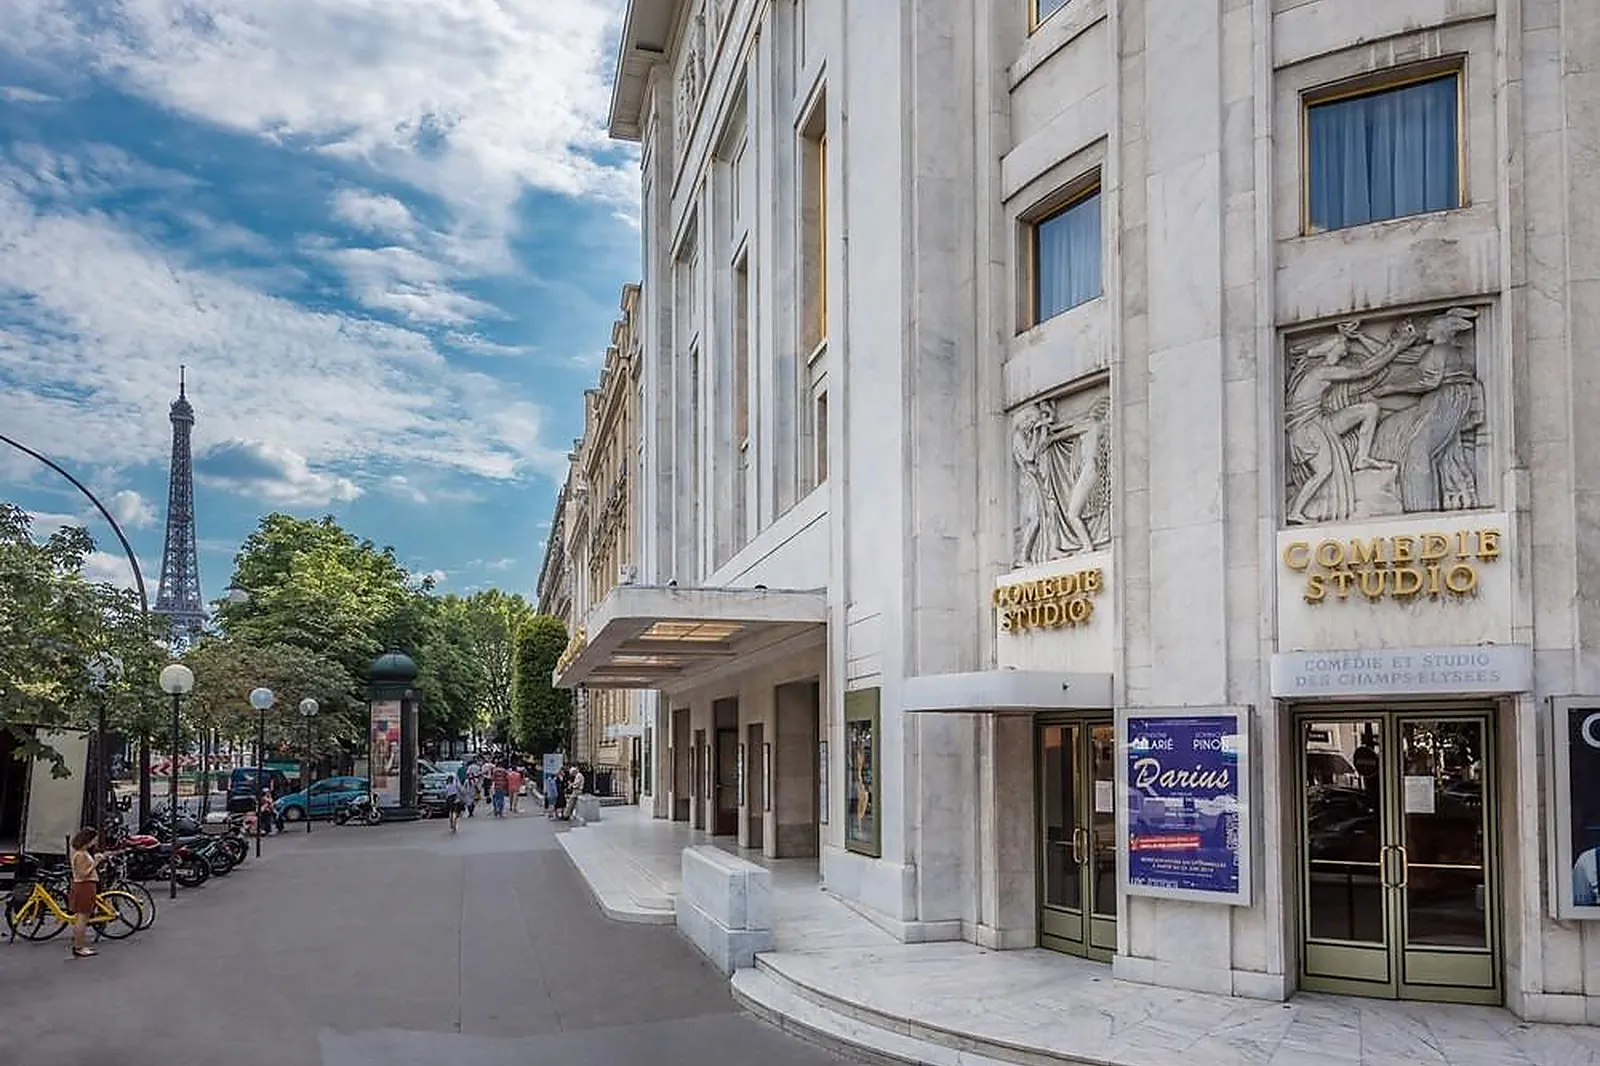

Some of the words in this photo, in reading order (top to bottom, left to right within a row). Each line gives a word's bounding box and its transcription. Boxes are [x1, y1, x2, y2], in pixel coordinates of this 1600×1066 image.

[1283, 528, 1501, 570] COMEDIE
[992, 567, 1102, 607] COMEDIE
[1304, 563, 1479, 603] STUDIO
[1001, 598, 1093, 632] STUDIO
[1393, 655, 1414, 669] ET
[1422, 652, 1491, 668] STUDIO
[1295, 674, 1331, 687] DES
